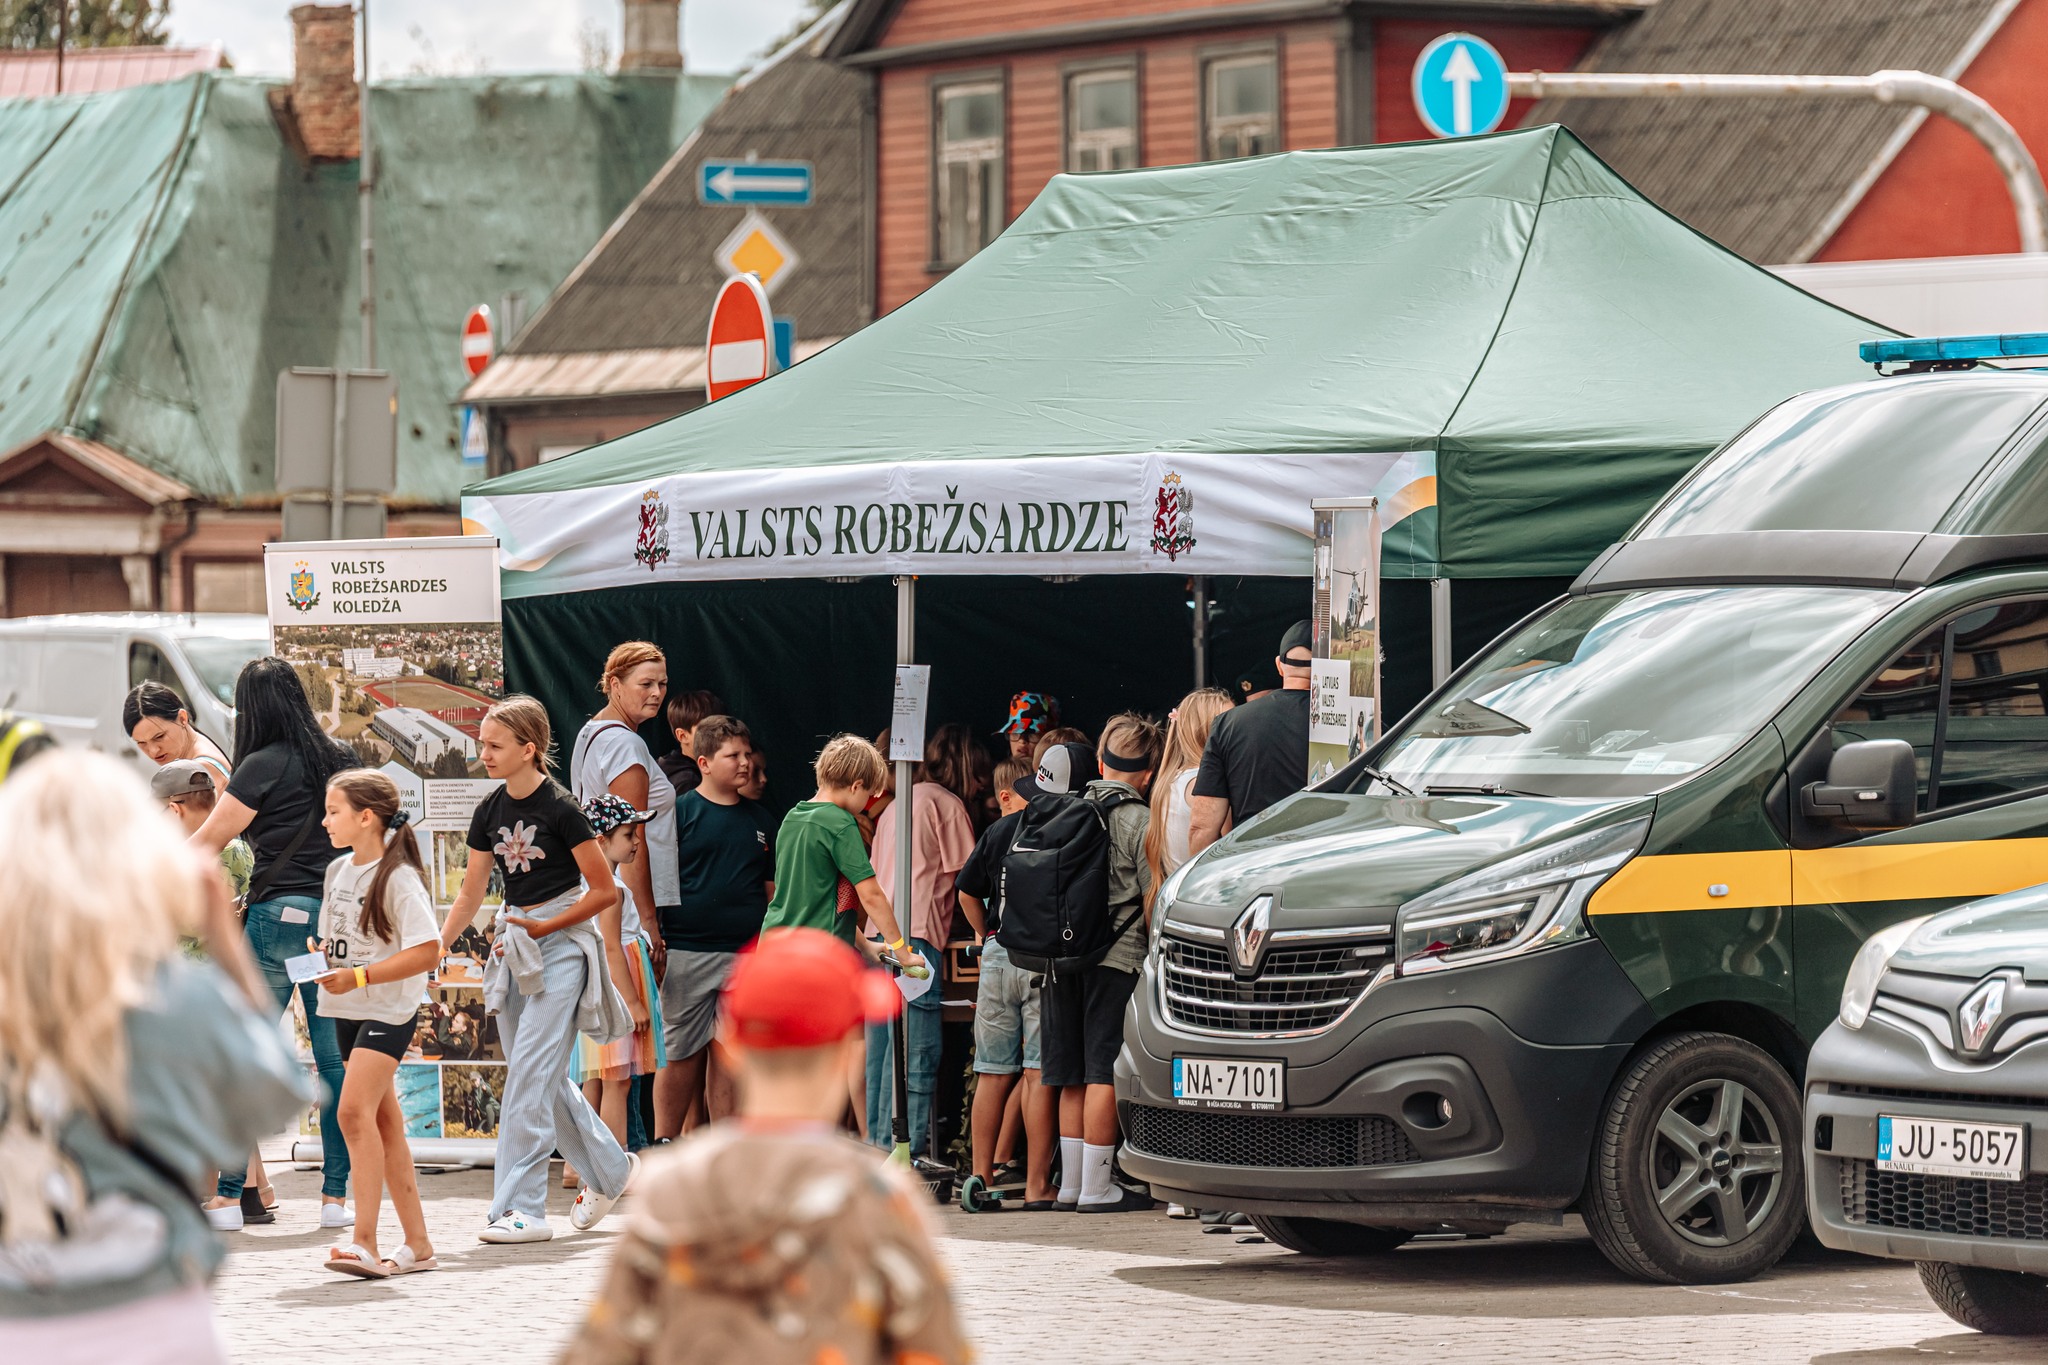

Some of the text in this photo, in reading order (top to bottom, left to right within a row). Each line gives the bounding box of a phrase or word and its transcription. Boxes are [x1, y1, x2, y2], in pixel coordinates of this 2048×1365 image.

[689, 484, 1130, 561] VALSTS ROBEŽSARDZE
[331, 560, 385, 575] VALSTS
[332, 578, 448, 594] ROBEŽSARDZES
[333, 597, 402, 614] KOLEDŽA
[1174, 1081, 1183, 1091] LV
[1187, 1063, 1276, 1098] NA-7101
[1178, 1099, 1198, 1107] RENAULT
[1880, 1143, 1891, 1154] LV
[1898, 1124, 2018, 1166] JU-5057
[1884, 1161, 1915, 1171] RENAULT
